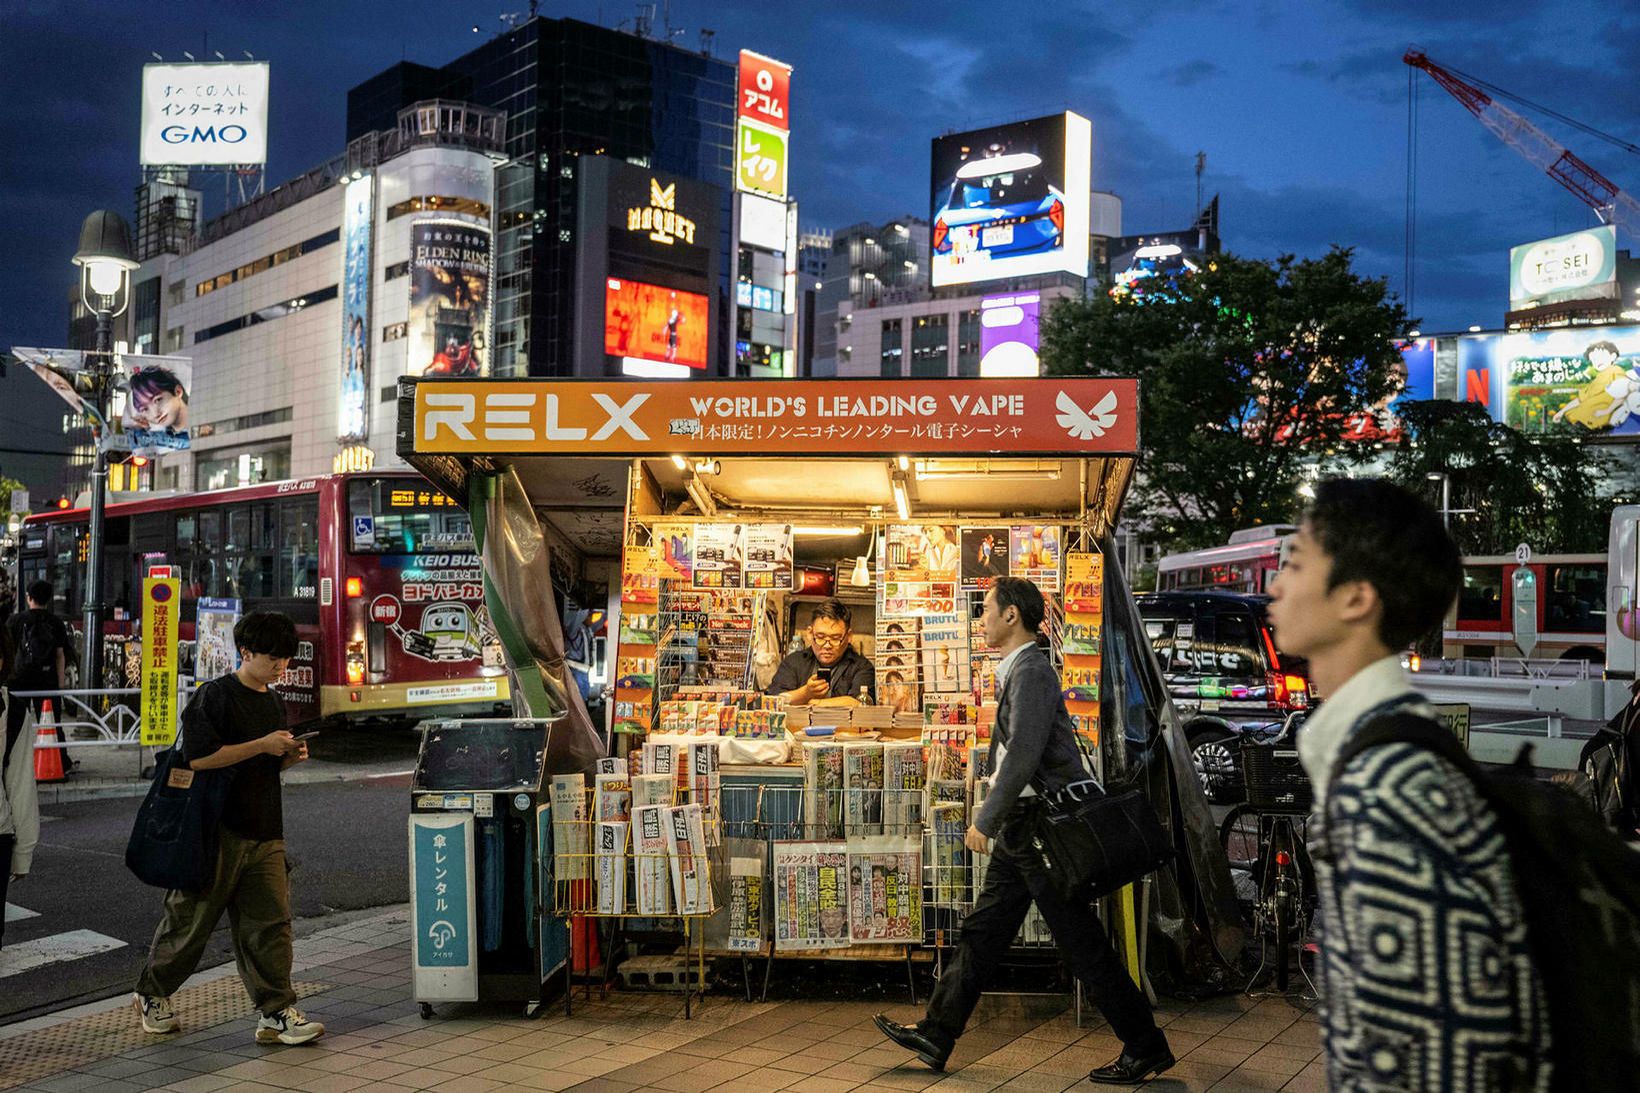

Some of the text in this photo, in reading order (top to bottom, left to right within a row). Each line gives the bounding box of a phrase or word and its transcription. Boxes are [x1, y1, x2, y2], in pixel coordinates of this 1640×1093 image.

[161, 102, 248, 116] インターネット
[745, 90, 784, 120] アコム
[161, 125, 247, 143] GMO
[417, 245, 489, 266] ELDEN RING
[424, 393, 652, 441] RELX
[690, 395, 1024, 418] WORLD'S LEADING VAPE
[413, 555, 480, 567] KEIO BUS
[1518, 547, 1529, 559] 21
[152, 605, 168, 668] 違法駐車禁止
[433, 834, 448, 911] 傘レンタル
[732, 938, 757, 949] 東スポ
